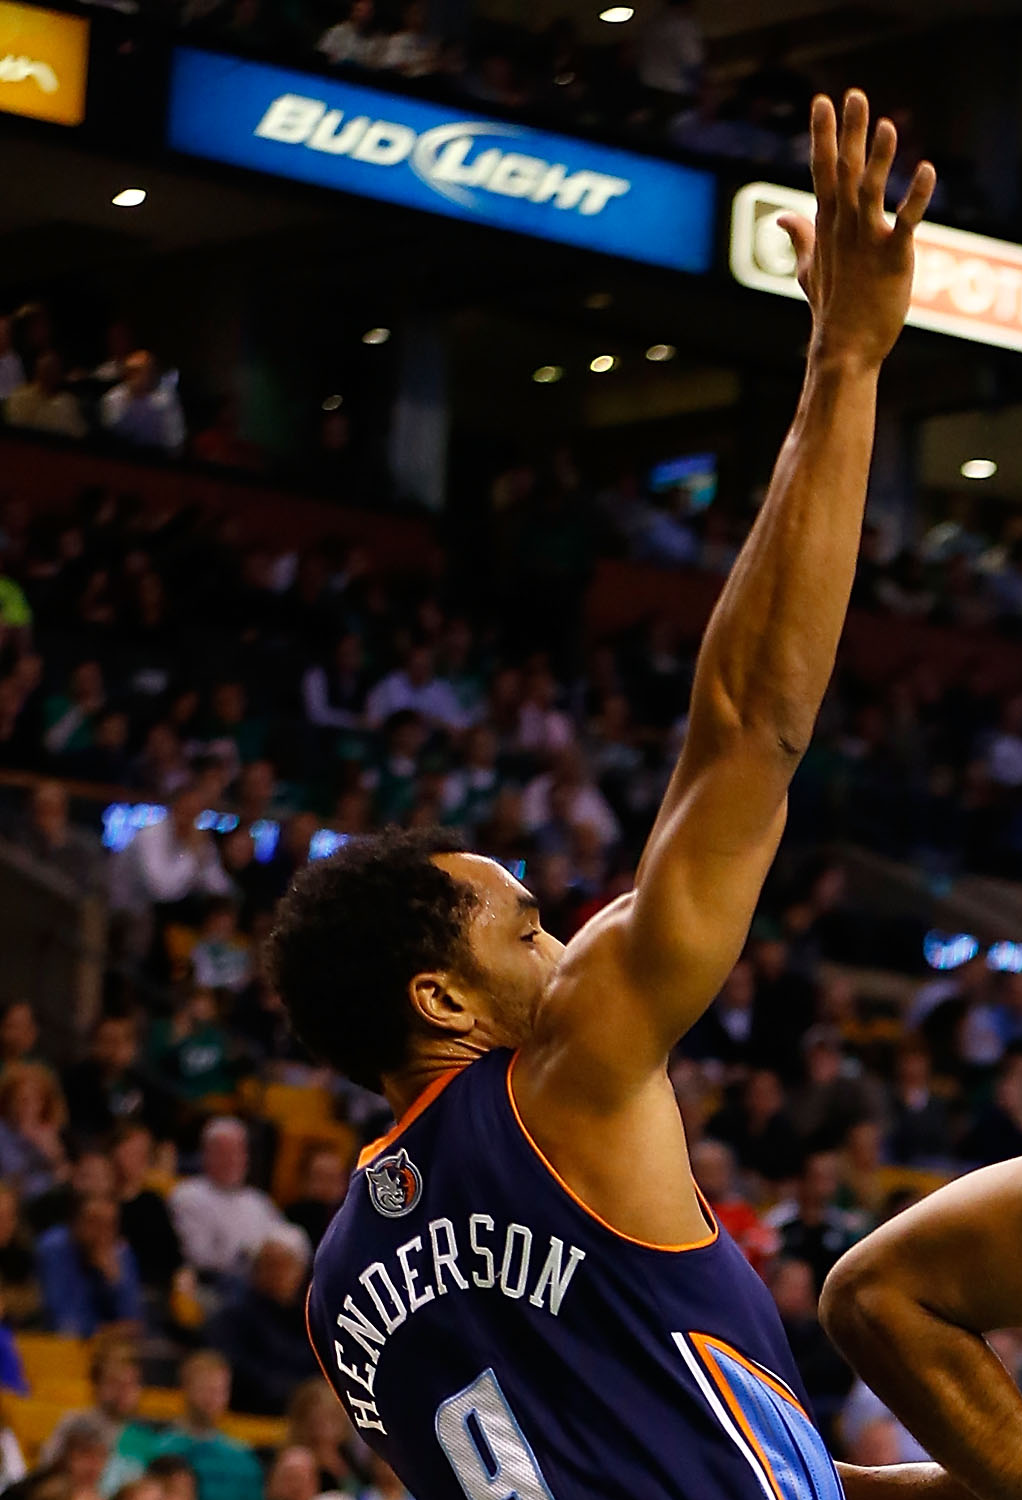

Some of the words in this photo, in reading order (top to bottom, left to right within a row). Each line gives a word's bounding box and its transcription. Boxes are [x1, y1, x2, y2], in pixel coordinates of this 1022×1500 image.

[254, 93, 418, 166] BUD
[431, 136, 631, 215] LIGHT
[334, 1212, 587, 1435] HENDERSON
